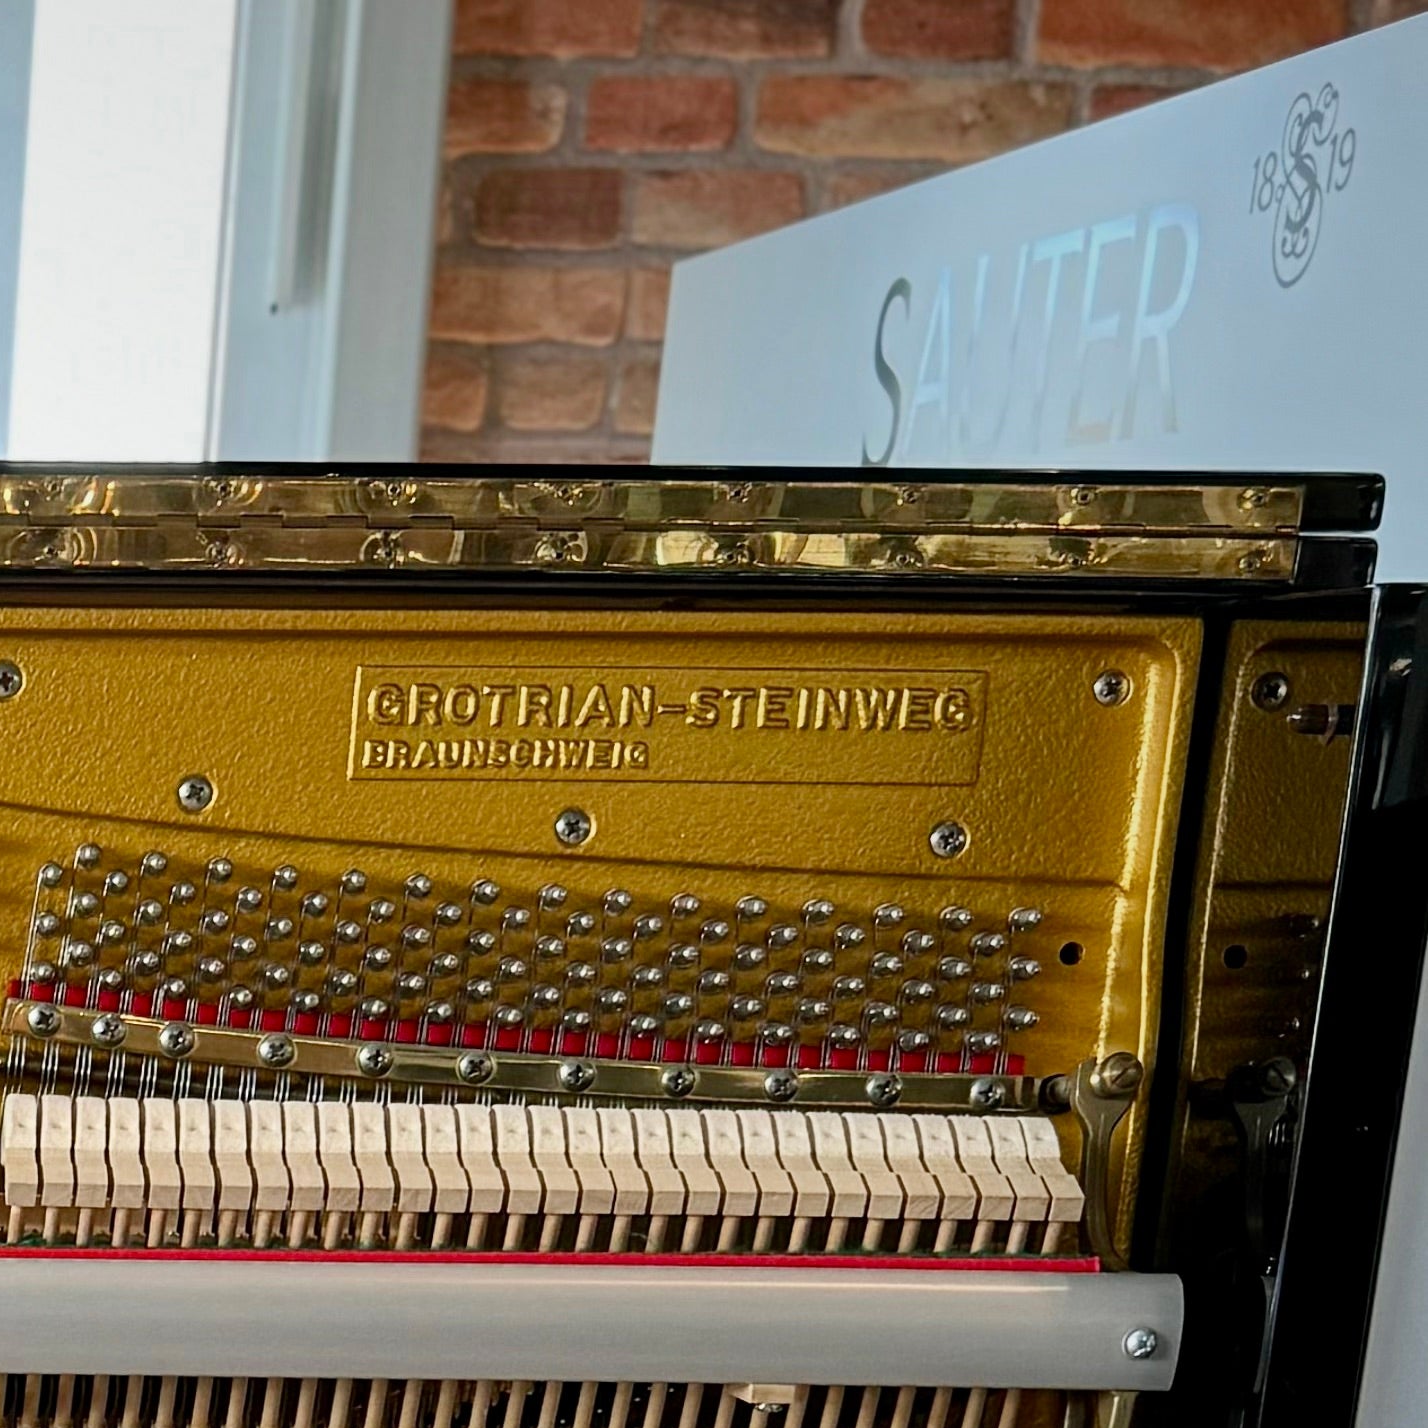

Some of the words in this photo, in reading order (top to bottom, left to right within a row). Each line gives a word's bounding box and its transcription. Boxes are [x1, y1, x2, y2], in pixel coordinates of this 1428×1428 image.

[1249, 150, 1278, 215] 18
[1326, 126, 1357, 193] 19
[861, 203, 1200, 467] SAUTER
[365, 682, 972, 732] GROTRIAN-STEINWEG
[360, 737, 650, 770] BRAUNSCHWEIG
